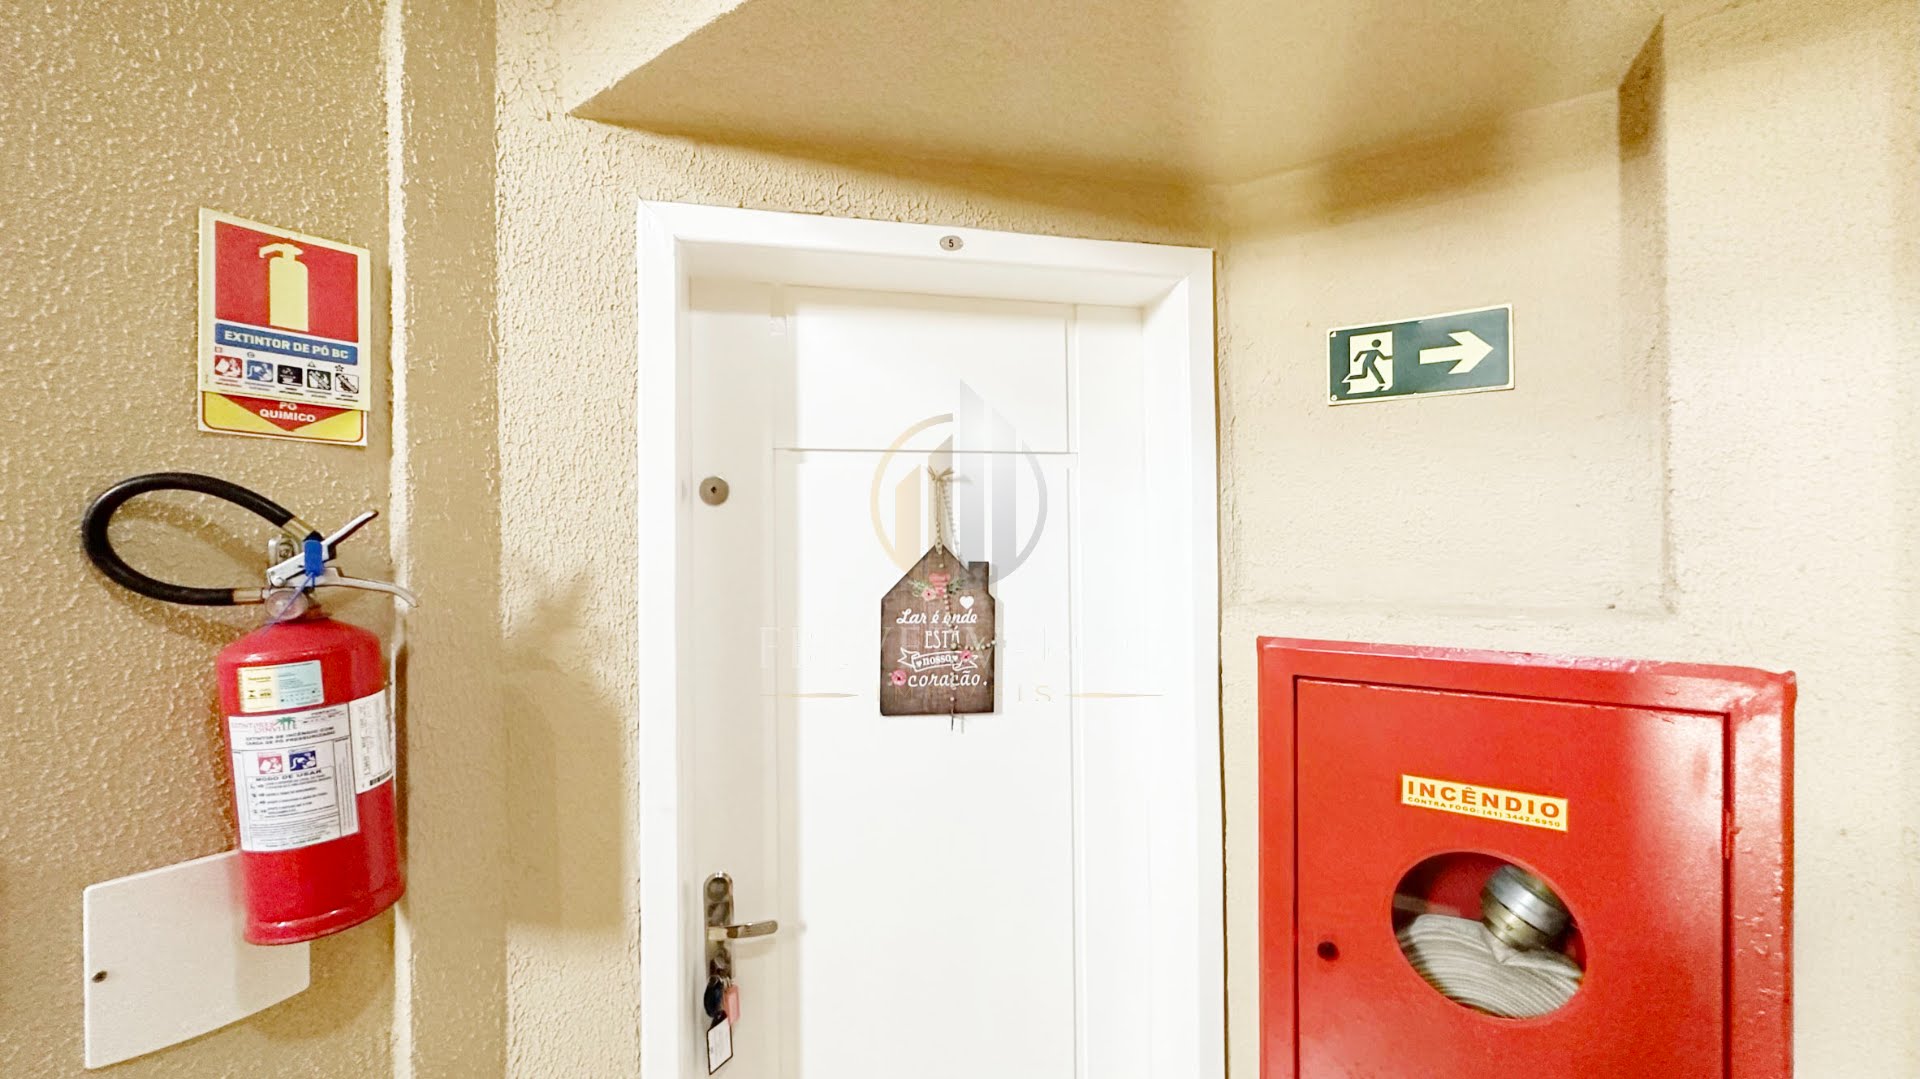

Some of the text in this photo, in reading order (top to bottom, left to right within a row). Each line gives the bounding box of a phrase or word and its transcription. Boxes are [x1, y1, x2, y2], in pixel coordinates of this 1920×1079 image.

[948, 238, 954, 248] 5
[224, 330, 349, 359] EXTINTOR DE PÓ BC
[896, 608, 978, 625] Lar é onde
[924, 625, 960, 649] ESTÁ
[922, 654, 952, 666] nosso
[1407, 796, 1447, 808] CONTRA
[1408, 780, 1560, 819] INCÊNDIO
